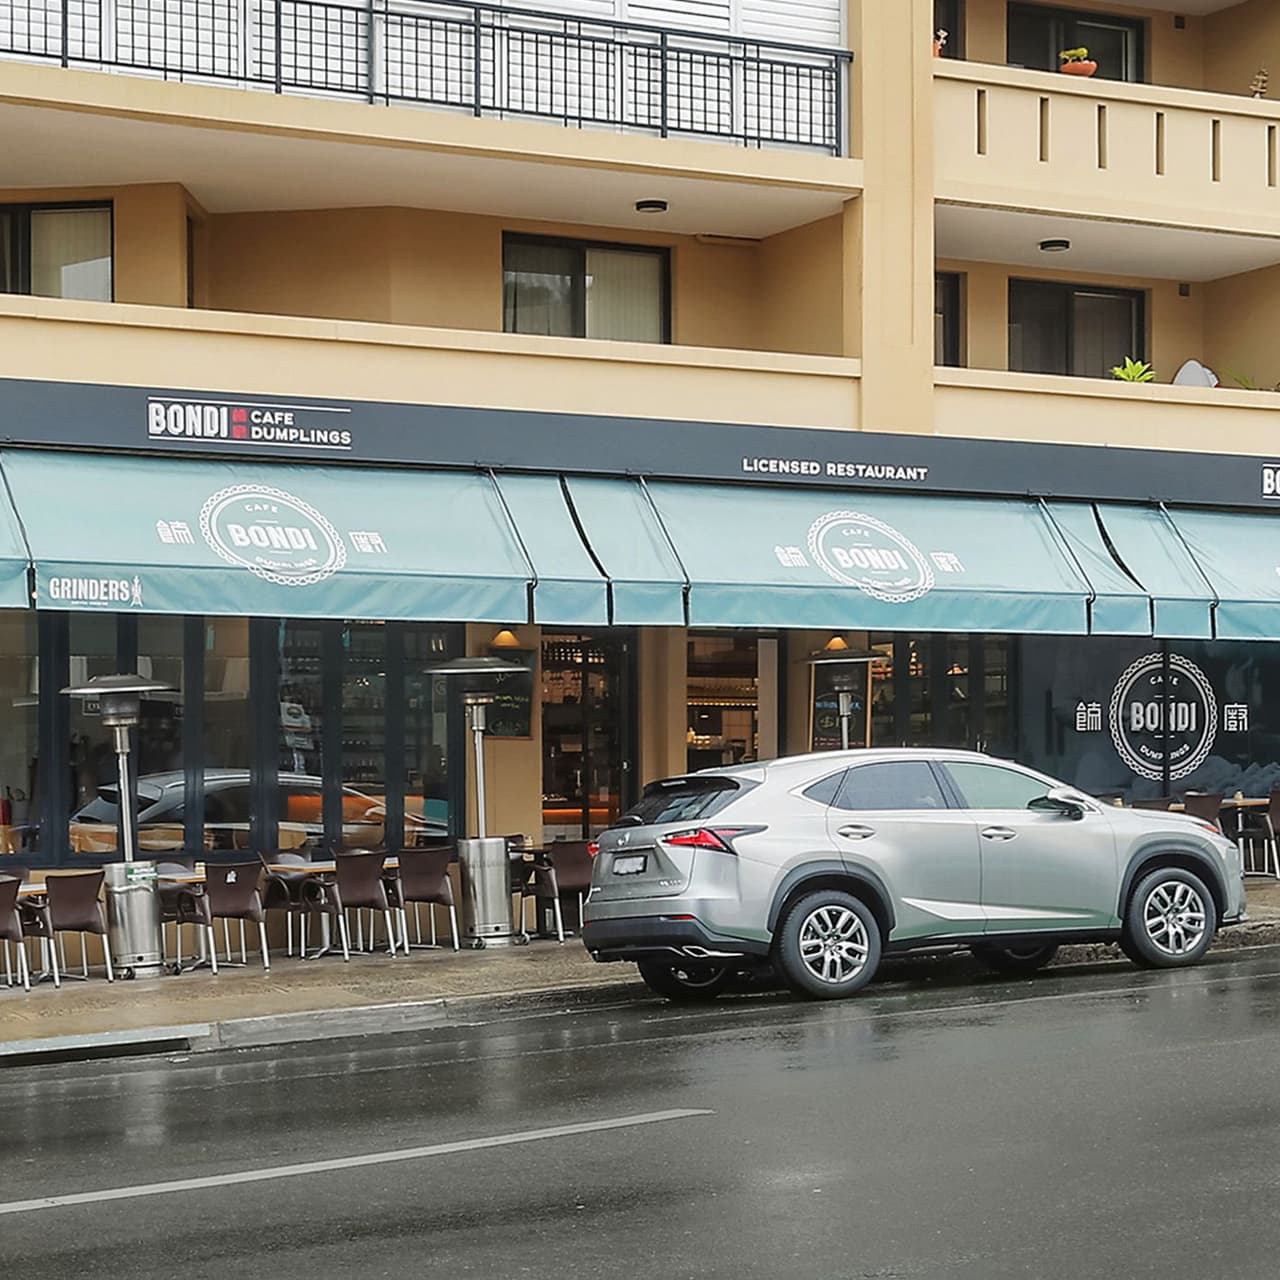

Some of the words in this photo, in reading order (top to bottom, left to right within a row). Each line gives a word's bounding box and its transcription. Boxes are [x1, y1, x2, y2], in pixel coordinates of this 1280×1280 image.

[148, 403, 228, 438] BONDI
[250, 410, 294, 425] CAFE
[251, 426, 352, 444] DUMPLINGS
[743, 458, 820, 475] LICENSED
[826, 462, 928, 481] RESTAURANT
[245, 504, 279, 513] CAFE
[227, 524, 318, 551] BONDI
[832, 547, 909, 571] BONDI
[50, 577, 130, 601] GRINDERS
